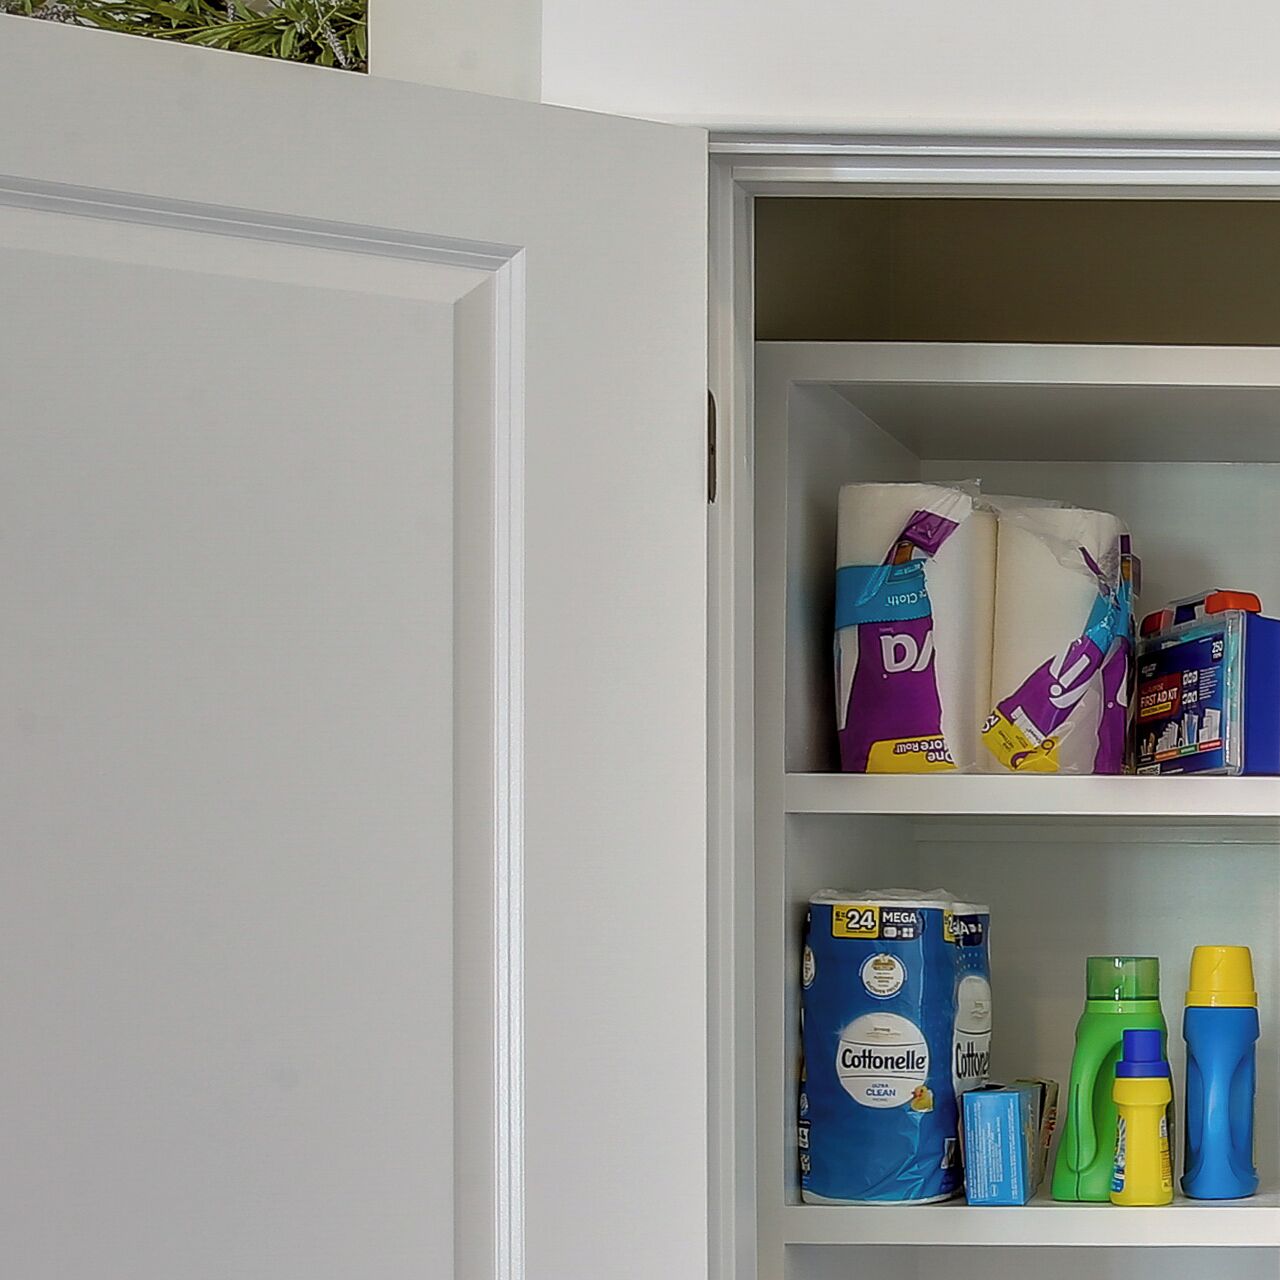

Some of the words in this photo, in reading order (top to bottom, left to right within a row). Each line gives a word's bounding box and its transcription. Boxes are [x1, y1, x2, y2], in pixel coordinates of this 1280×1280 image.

[887, 592, 918, 606] Cloth
[847, 910, 875, 929] 24
[882, 911, 917, 924] MEGA
[841, 1048, 927, 1070] Cottonelle
[865, 1088, 897, 1097] CLEAN
